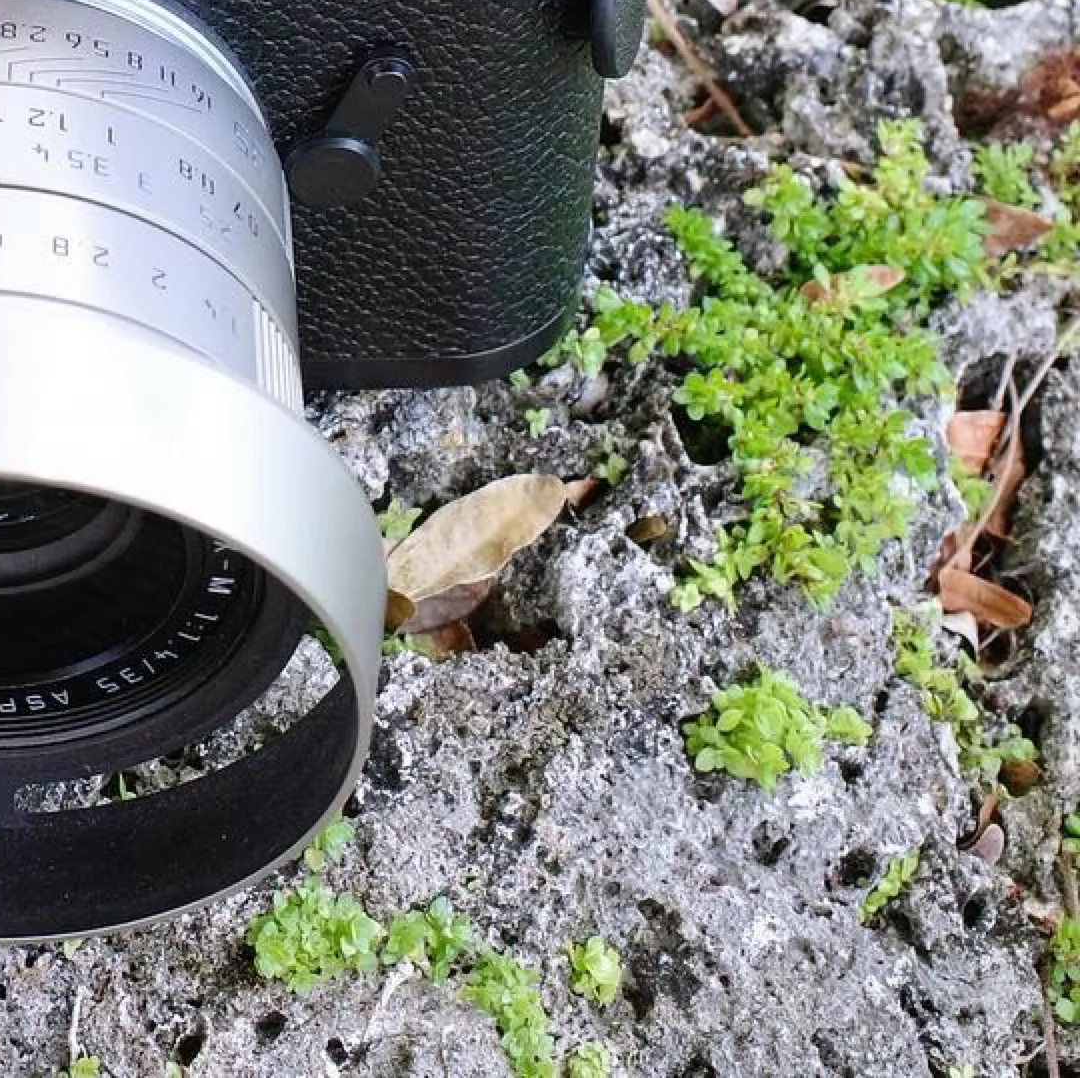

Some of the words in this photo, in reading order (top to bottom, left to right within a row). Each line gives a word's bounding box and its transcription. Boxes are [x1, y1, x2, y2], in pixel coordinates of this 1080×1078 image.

[127, 50, 143, 71] 8
[28, 107, 68, 133] 1.2
[107, 126, 118, 146] 1
[31, 143, 49, 163] 4
[66, 149, 111, 177] 3.5
[137, 172, 152, 194] 3
[151, 268, 167, 291] 2
